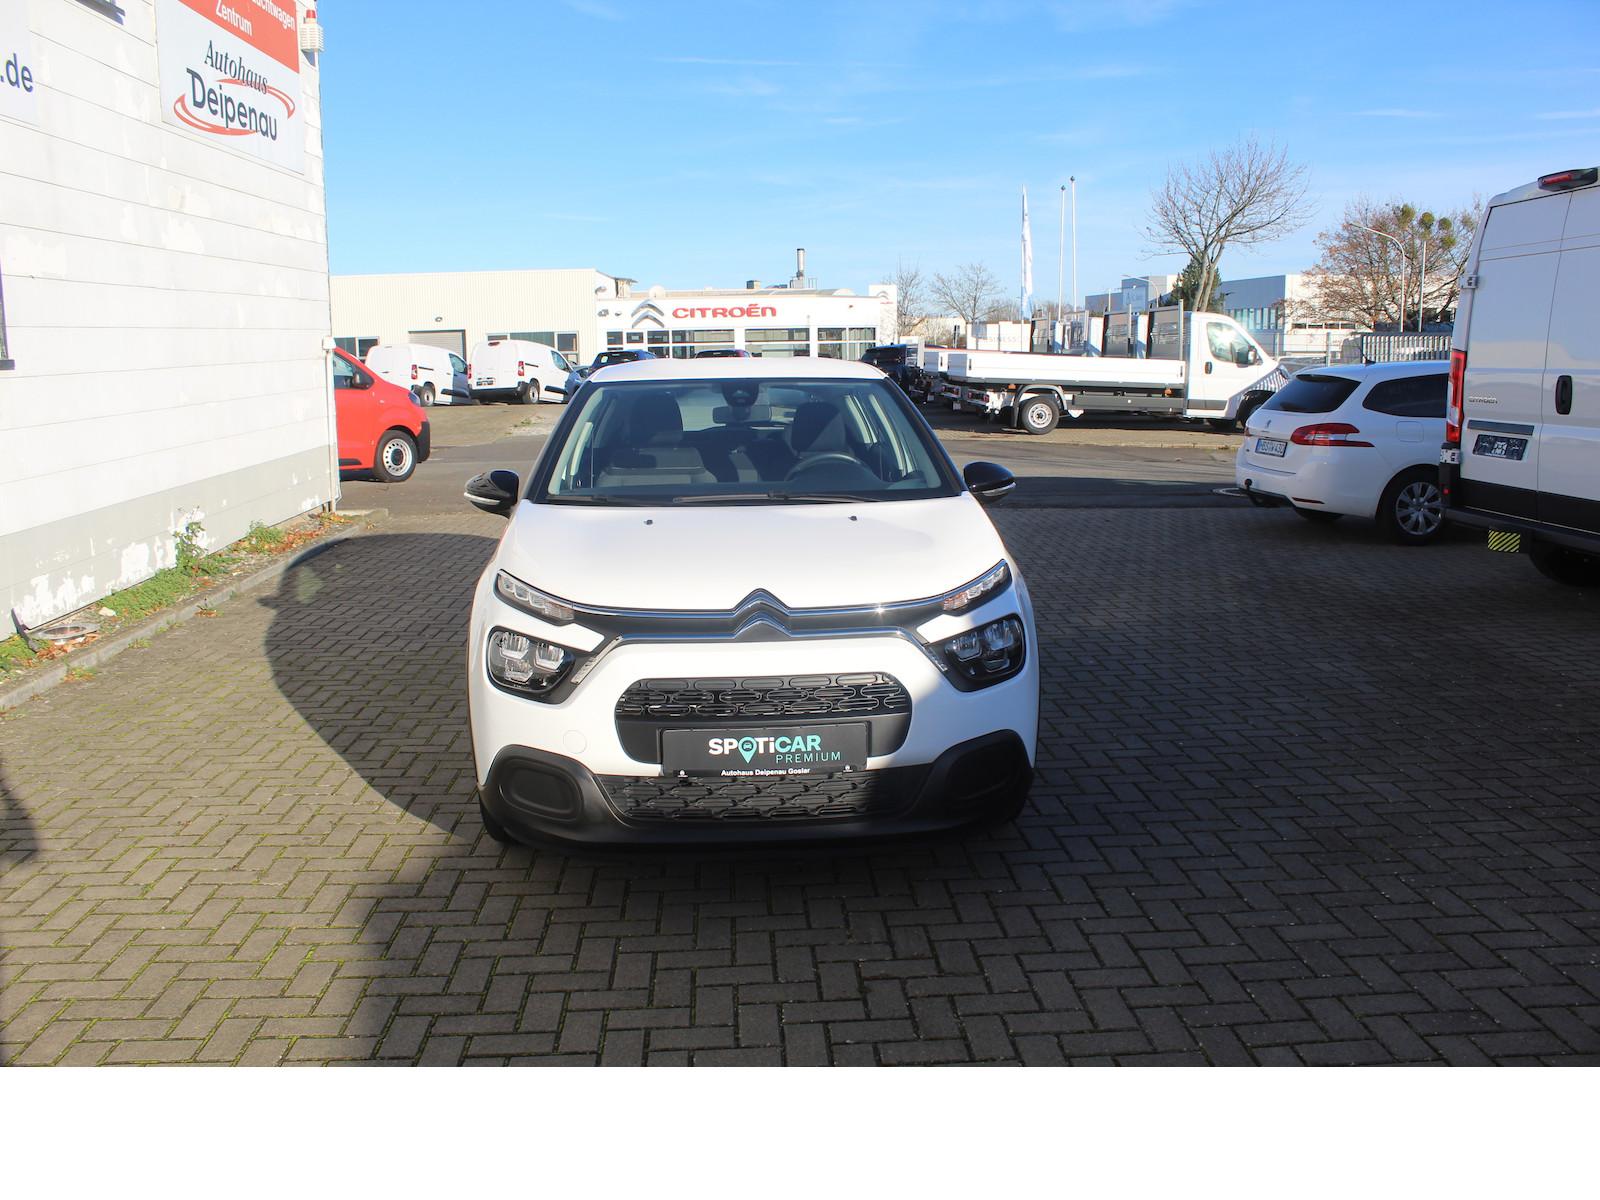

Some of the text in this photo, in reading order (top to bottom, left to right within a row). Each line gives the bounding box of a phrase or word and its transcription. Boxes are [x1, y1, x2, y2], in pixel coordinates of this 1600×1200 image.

[215, 0, 252, 36] Zentrum
[252, 0, 295, 31] uchtwagen
[204, 40, 268, 94] Autohaus
[186, 67, 277, 141] Deipenau
[755, 768, 787, 776] Deipenau
[788, 767, 811, 775] Goslar
[776, 751, 841, 764] PREMIUM
